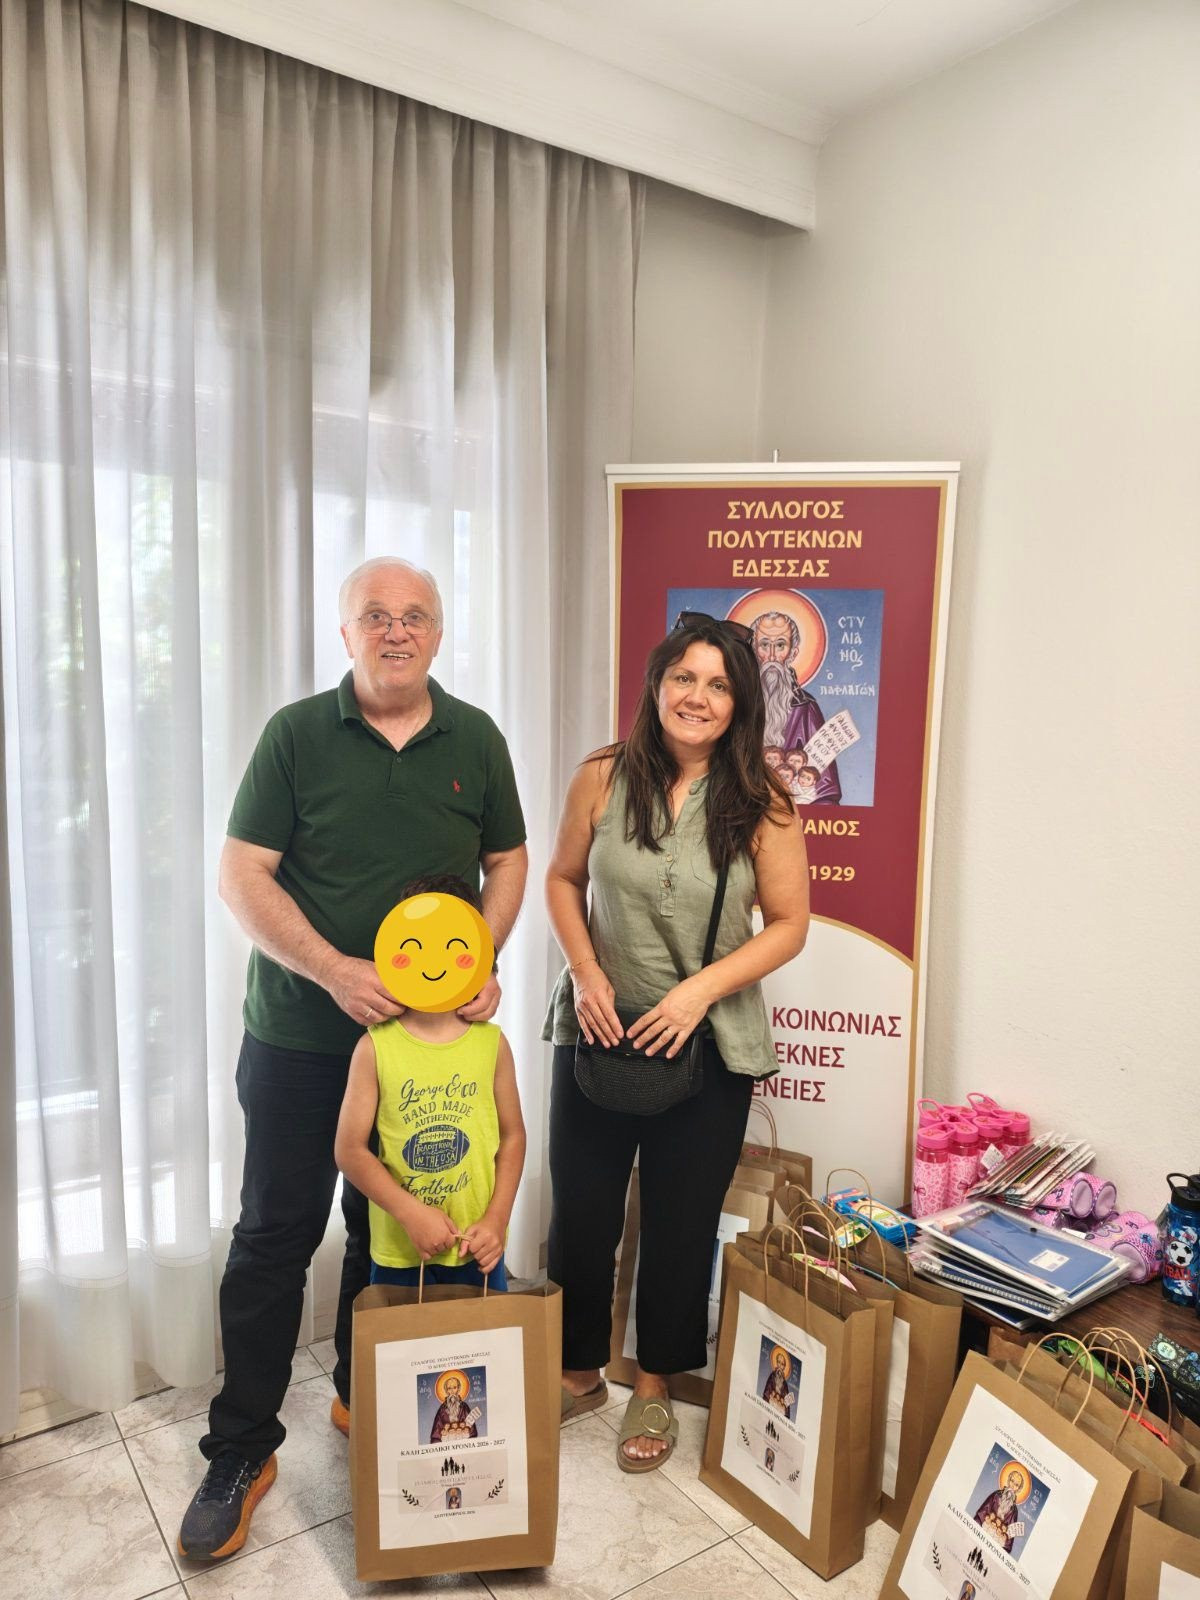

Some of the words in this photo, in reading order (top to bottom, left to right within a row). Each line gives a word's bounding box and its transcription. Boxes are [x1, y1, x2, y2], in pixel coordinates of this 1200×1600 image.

[727, 500, 844, 519] ΣΥΛΛΟΓΟΣ
[707, 530, 863, 549] ΠΟΛΥΤΕΚΝΩΝ
[732, 559, 830, 578] ΕΔΕΣΣΑΣ
[809, 865, 856, 882] 1929
[772, 1006, 902, 1037] ΚΟΙΝΩΝΙΑΣ
[399, 1079, 444, 1111] George
[402, 1101, 437, 1124] HAND
[442, 1100, 474, 1117] MADE
[415, 1113, 463, 1129] AUTHENTIC
[423, 1195, 447, 1206] 1967
